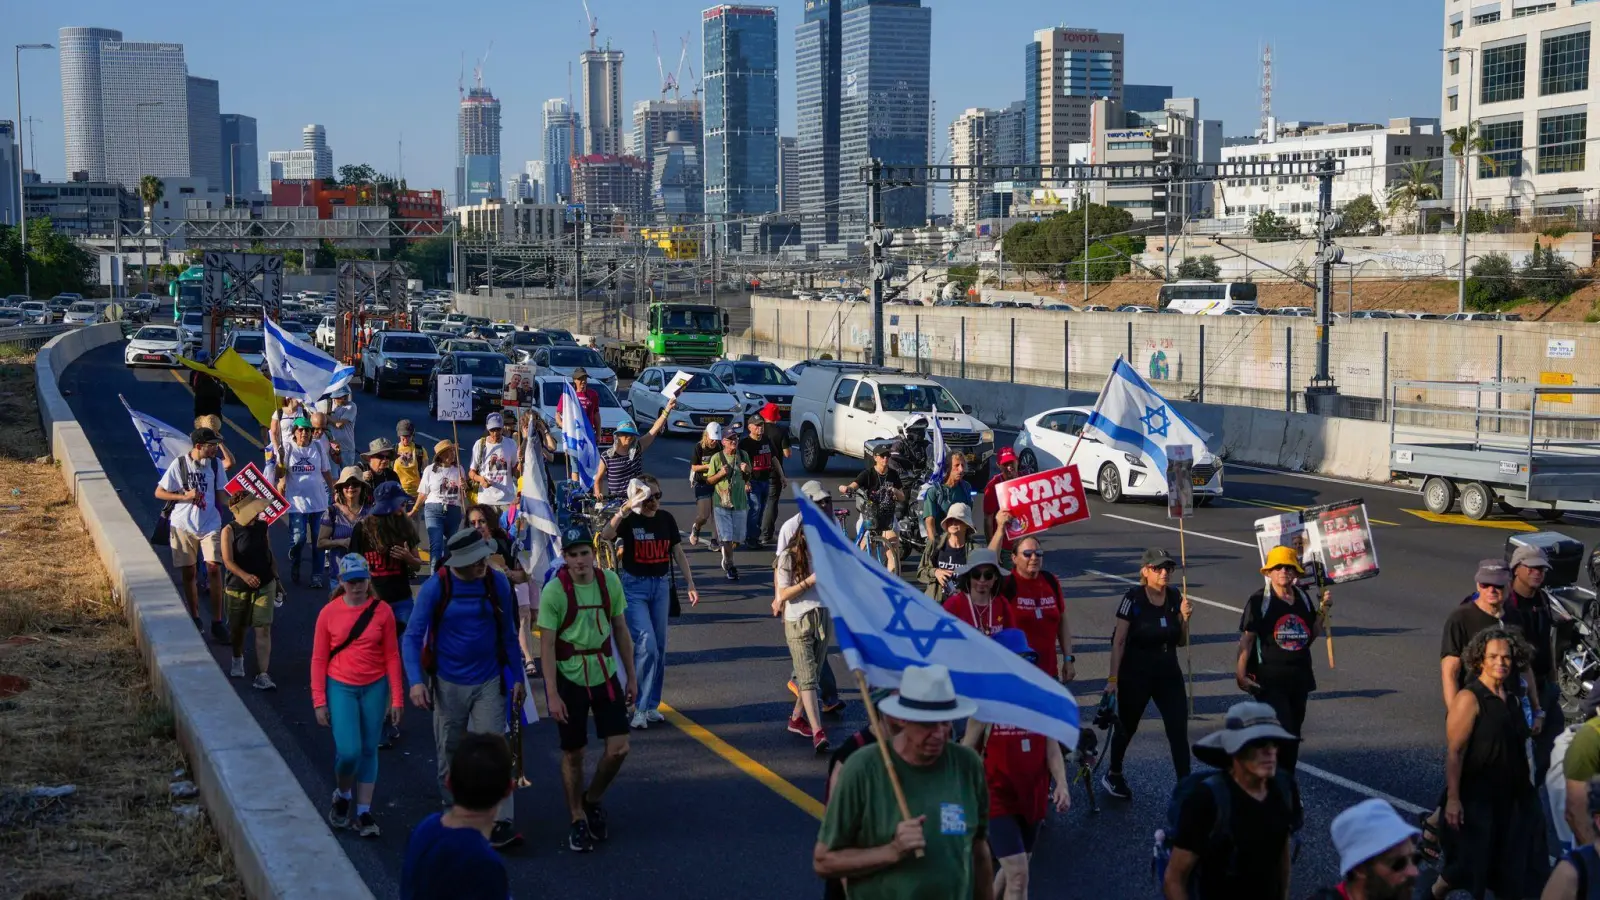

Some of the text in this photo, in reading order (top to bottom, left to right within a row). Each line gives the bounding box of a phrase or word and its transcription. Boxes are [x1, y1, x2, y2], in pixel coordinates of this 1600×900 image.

[1063, 33, 1099, 43] TOYOTA
[444, 376, 463, 385] את
[445, 388, 470, 399] אחיי
[452, 401, 465, 409] אני
[439, 410, 470, 420] מבקשת
[236, 474, 257, 495] CALLING
[244, 468, 257, 482] OUR
[254, 479, 275, 500] SISTERS
[272, 499, 284, 511] ARE
[1008, 472, 1075, 507] אמא
[1030, 495, 1079, 528] כאן
[634, 539, 670, 559] NOW!
